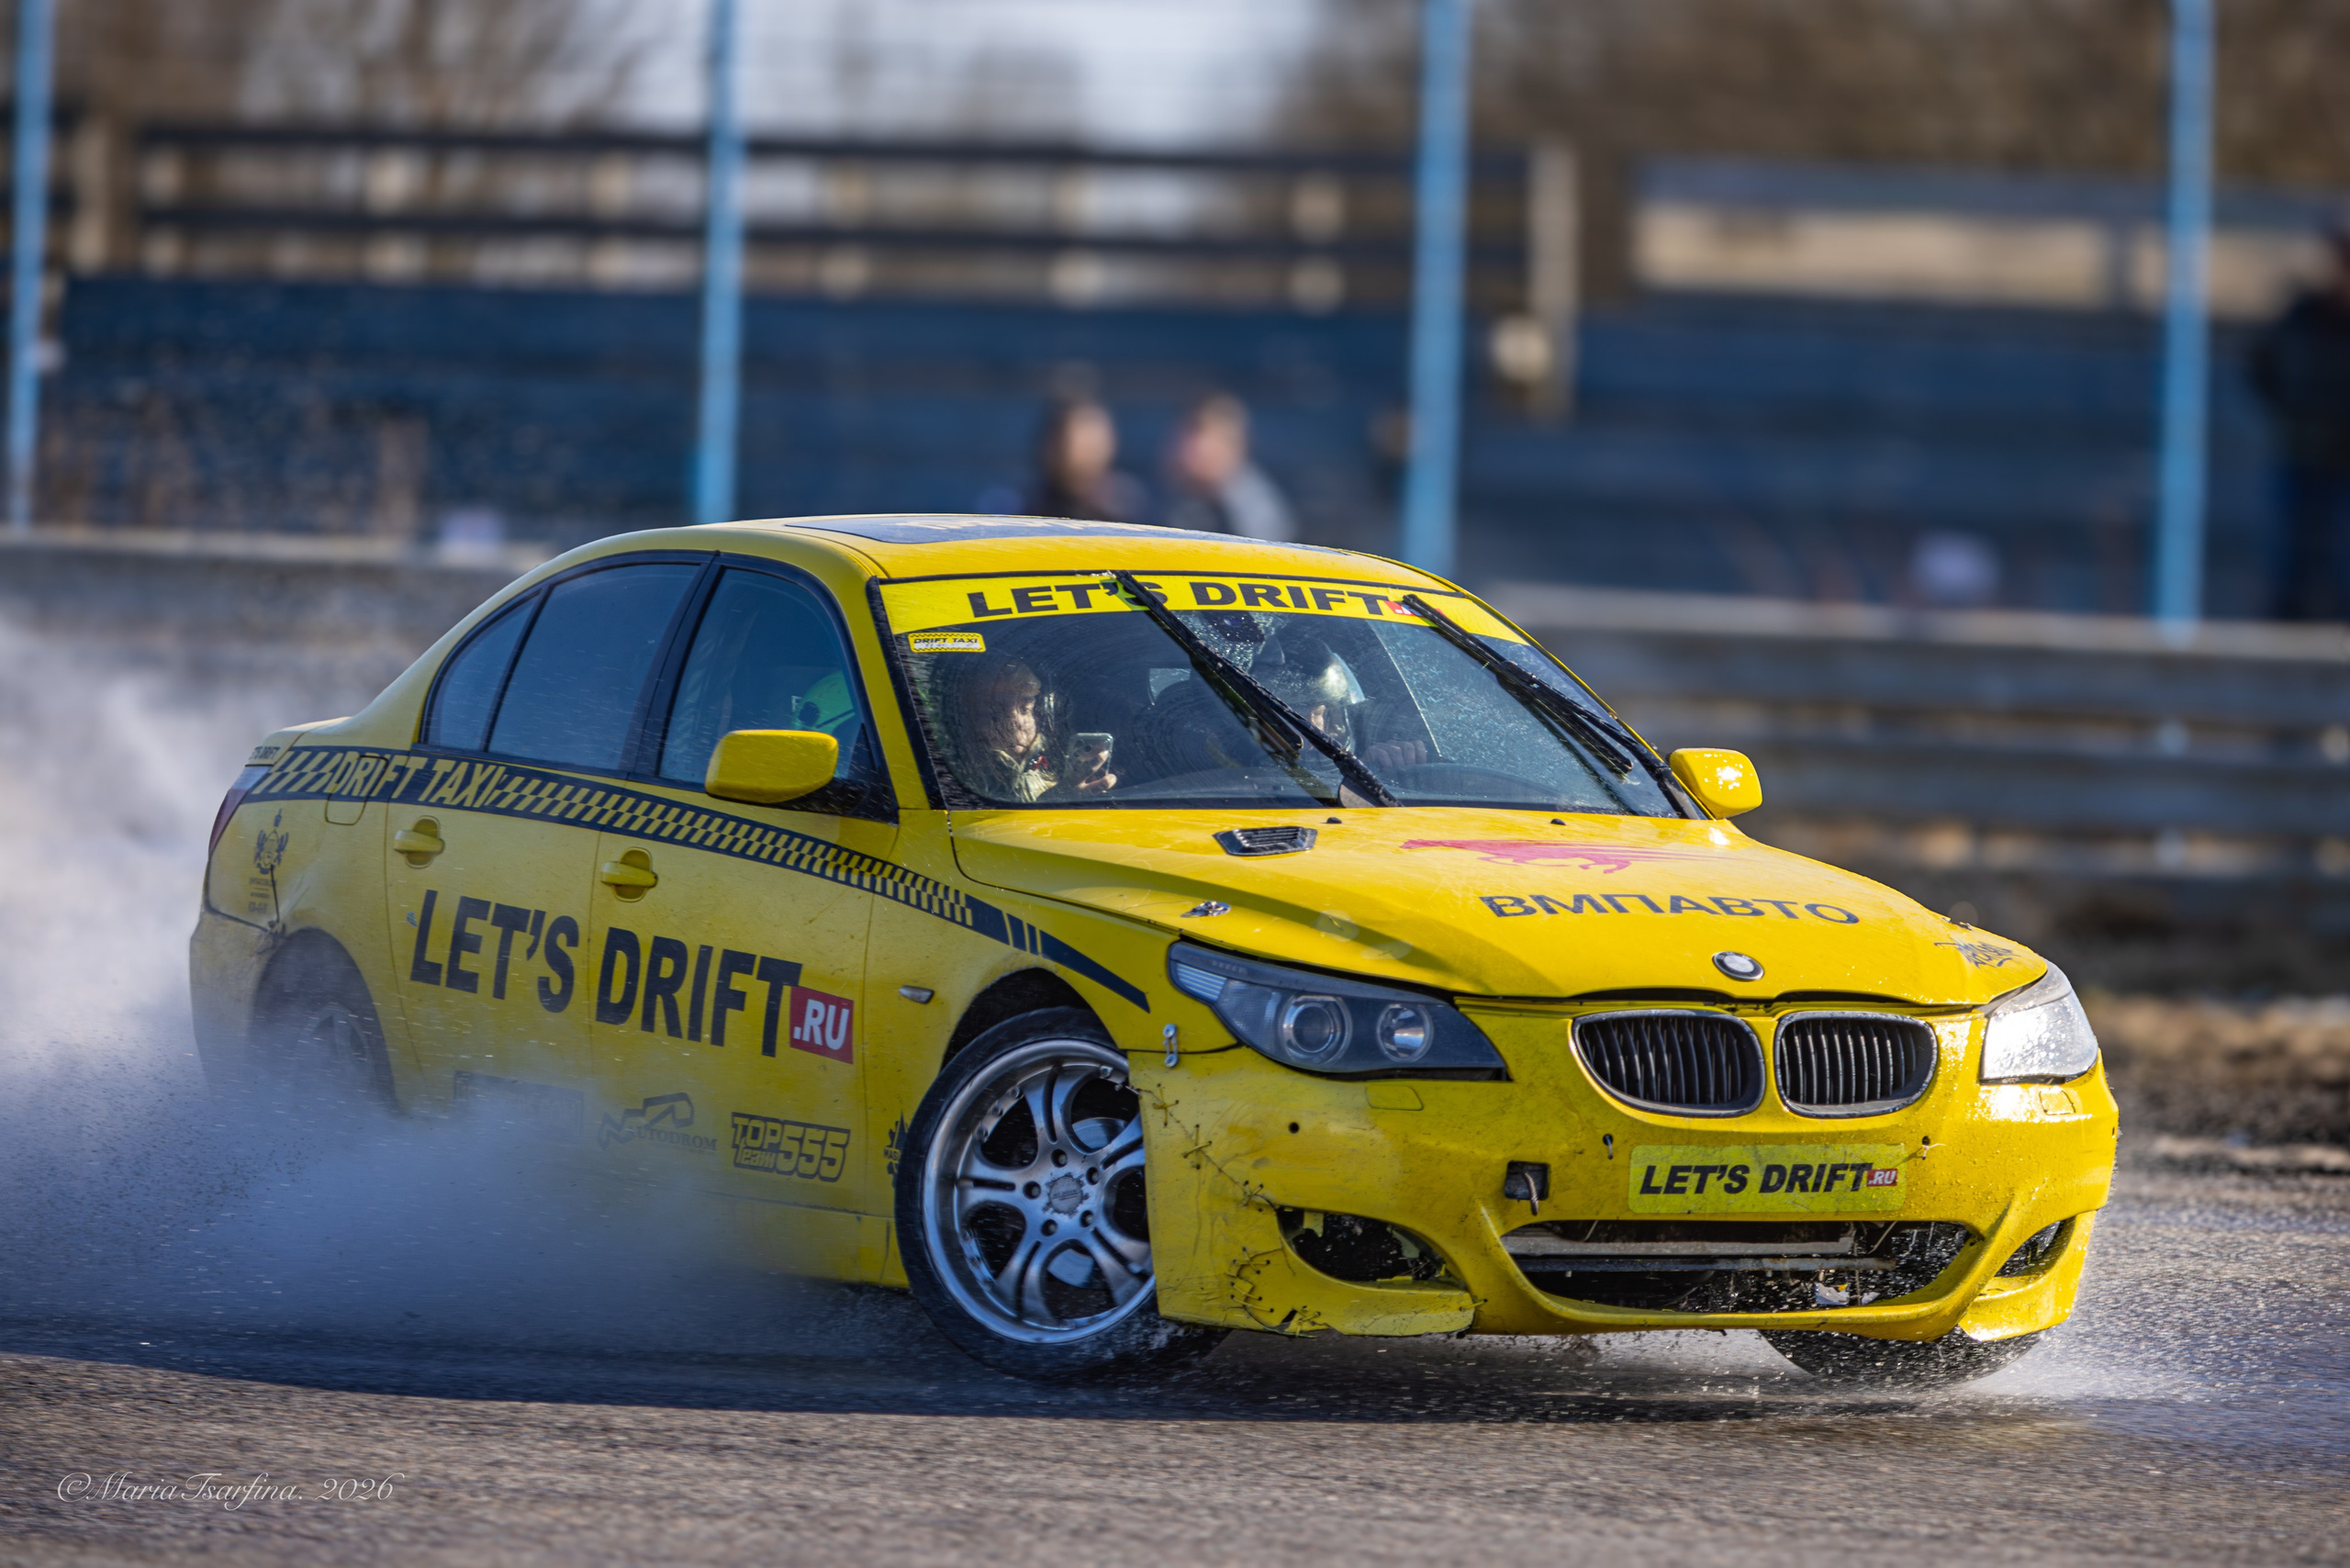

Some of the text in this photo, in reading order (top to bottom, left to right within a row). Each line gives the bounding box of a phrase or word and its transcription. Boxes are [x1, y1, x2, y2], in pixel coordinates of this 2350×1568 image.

[967, 581, 1168, 619] LET'S
[323, 751, 506, 808] DRIFT TAXI
[1478, 893, 1860, 924] ВМПАВТО
[409, 889, 579, 1014] LET'S
[733, 1114, 851, 1182] TOP 555
[1639, 1164, 1750, 1194] LET'S
